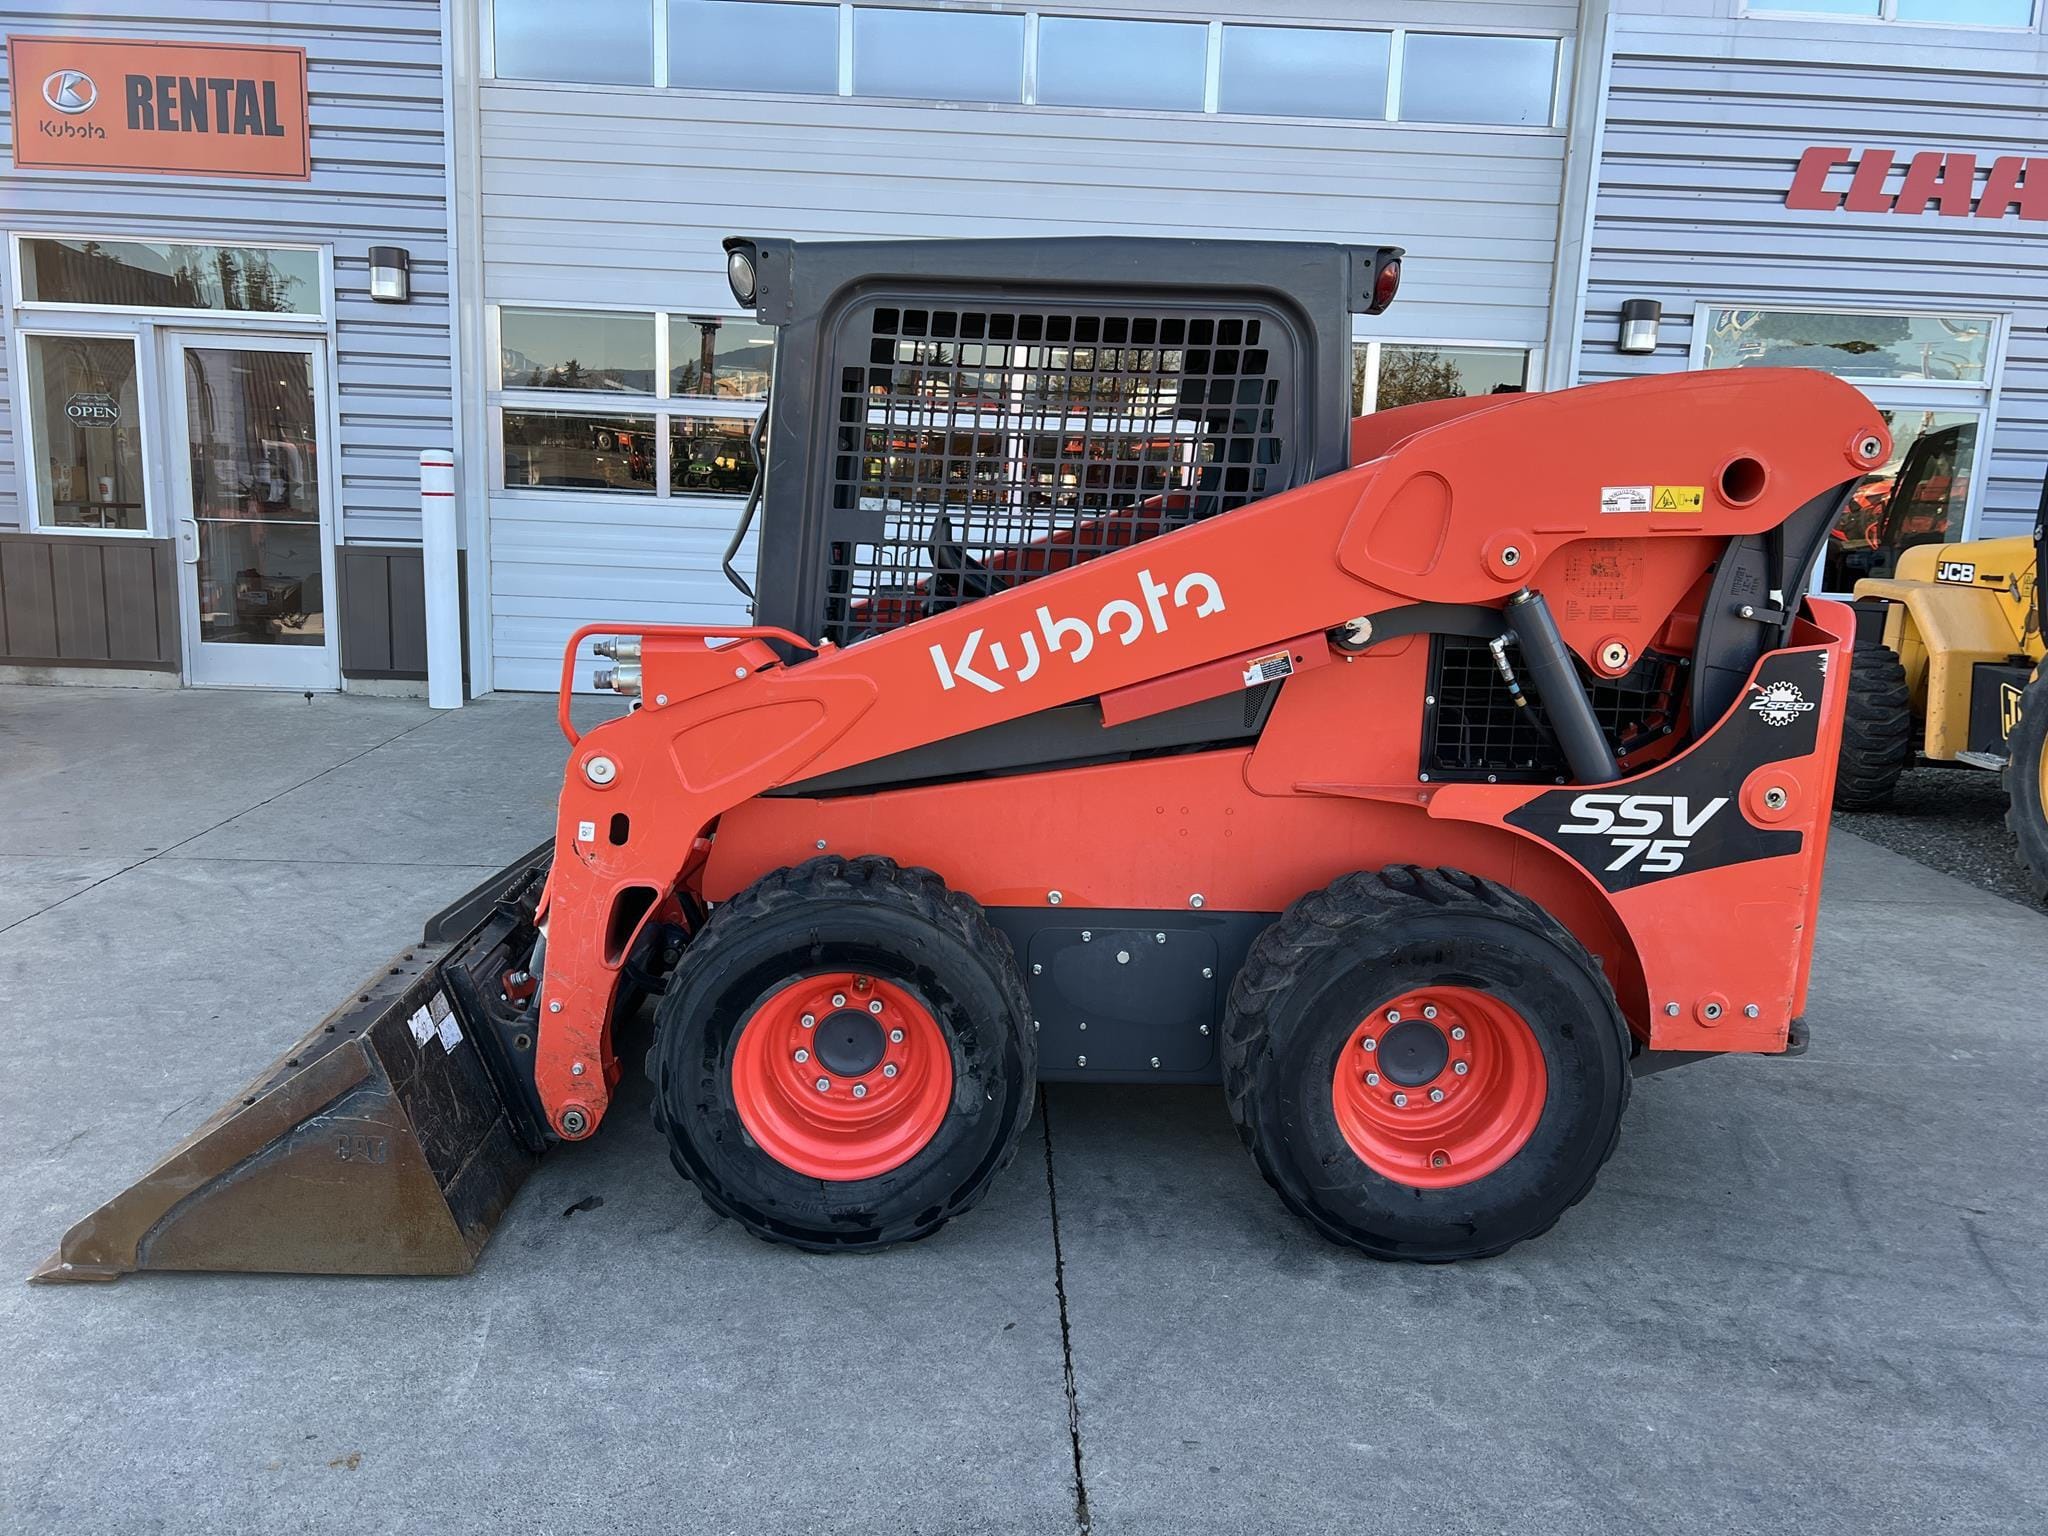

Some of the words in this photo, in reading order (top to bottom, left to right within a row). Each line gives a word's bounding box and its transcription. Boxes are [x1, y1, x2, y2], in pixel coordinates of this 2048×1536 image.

[125, 74, 285, 137] RENTAL
[39, 120, 106, 139] Kubota
[67, 405, 118, 418] OPEN
[1937, 563, 1975, 583] JCB
[928, 569, 1226, 693] Kubota
[1557, 794, 1730, 837] SSV
[1604, 838, 1691, 873] 75
